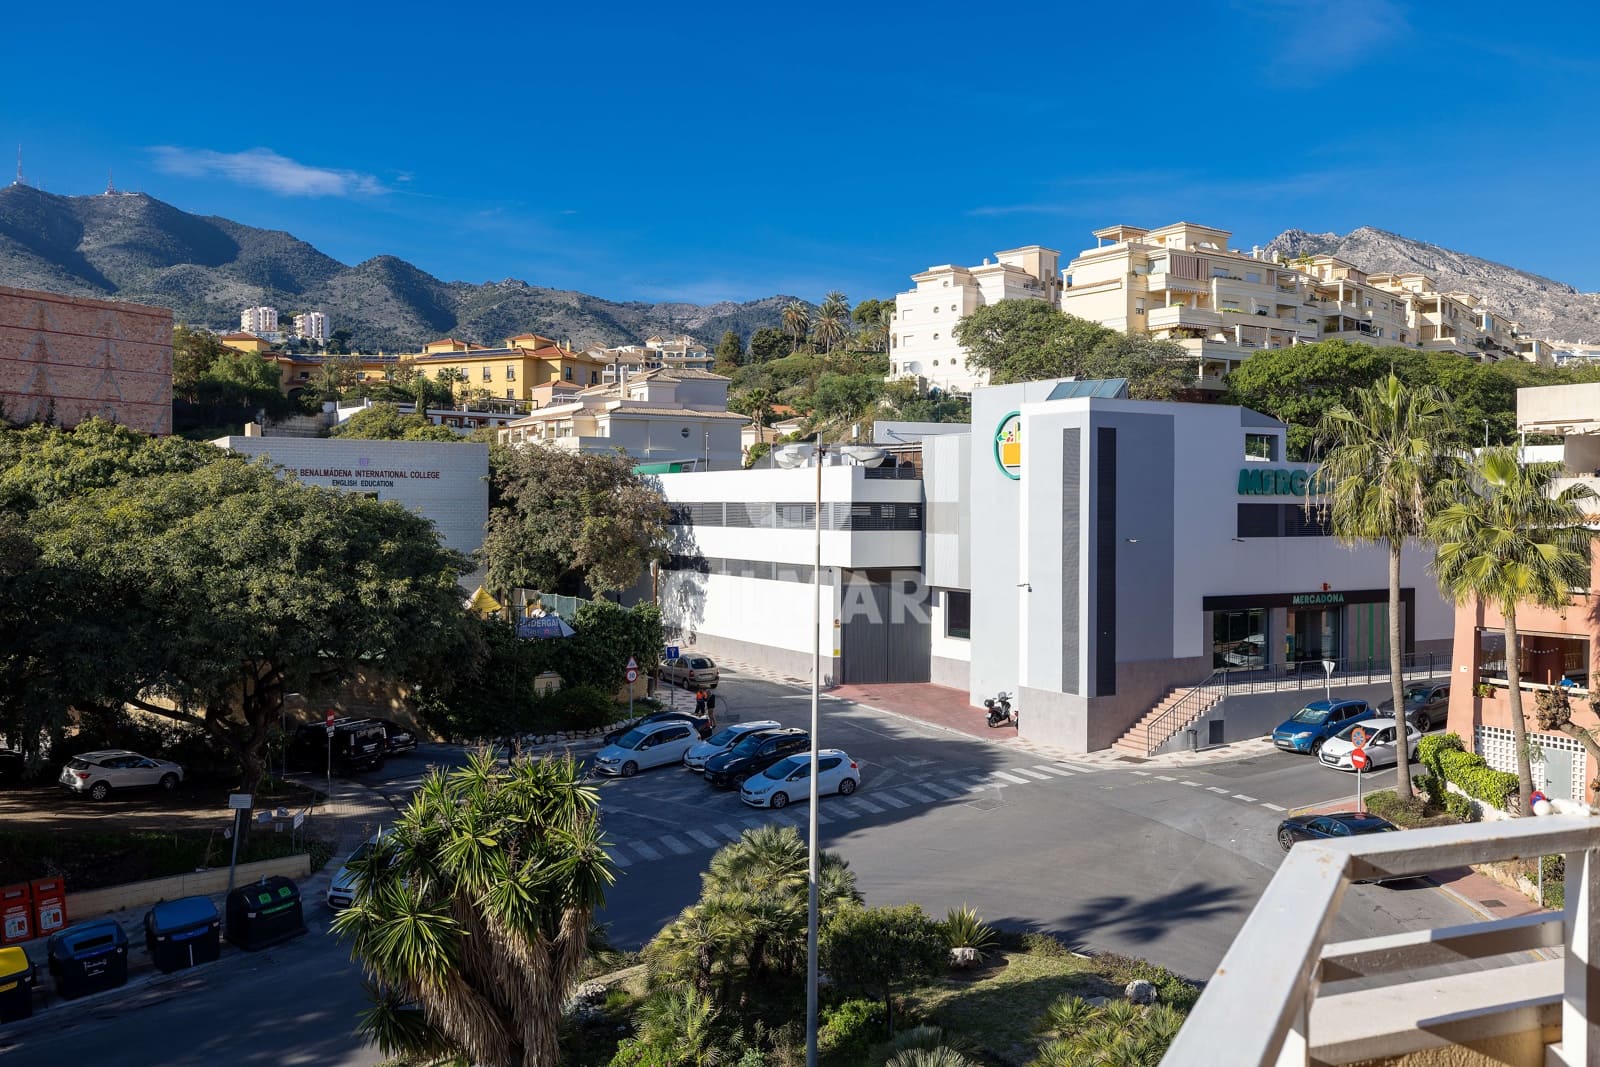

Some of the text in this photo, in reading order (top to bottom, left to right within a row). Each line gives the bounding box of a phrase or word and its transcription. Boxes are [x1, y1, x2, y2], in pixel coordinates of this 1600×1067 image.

[284, 469, 297, 477] TE
[355, 470, 408, 479] INTERNATIONAL
[410, 471, 440, 479] COLLEGE
[1292, 593, 1344, 605] MERCADONA
